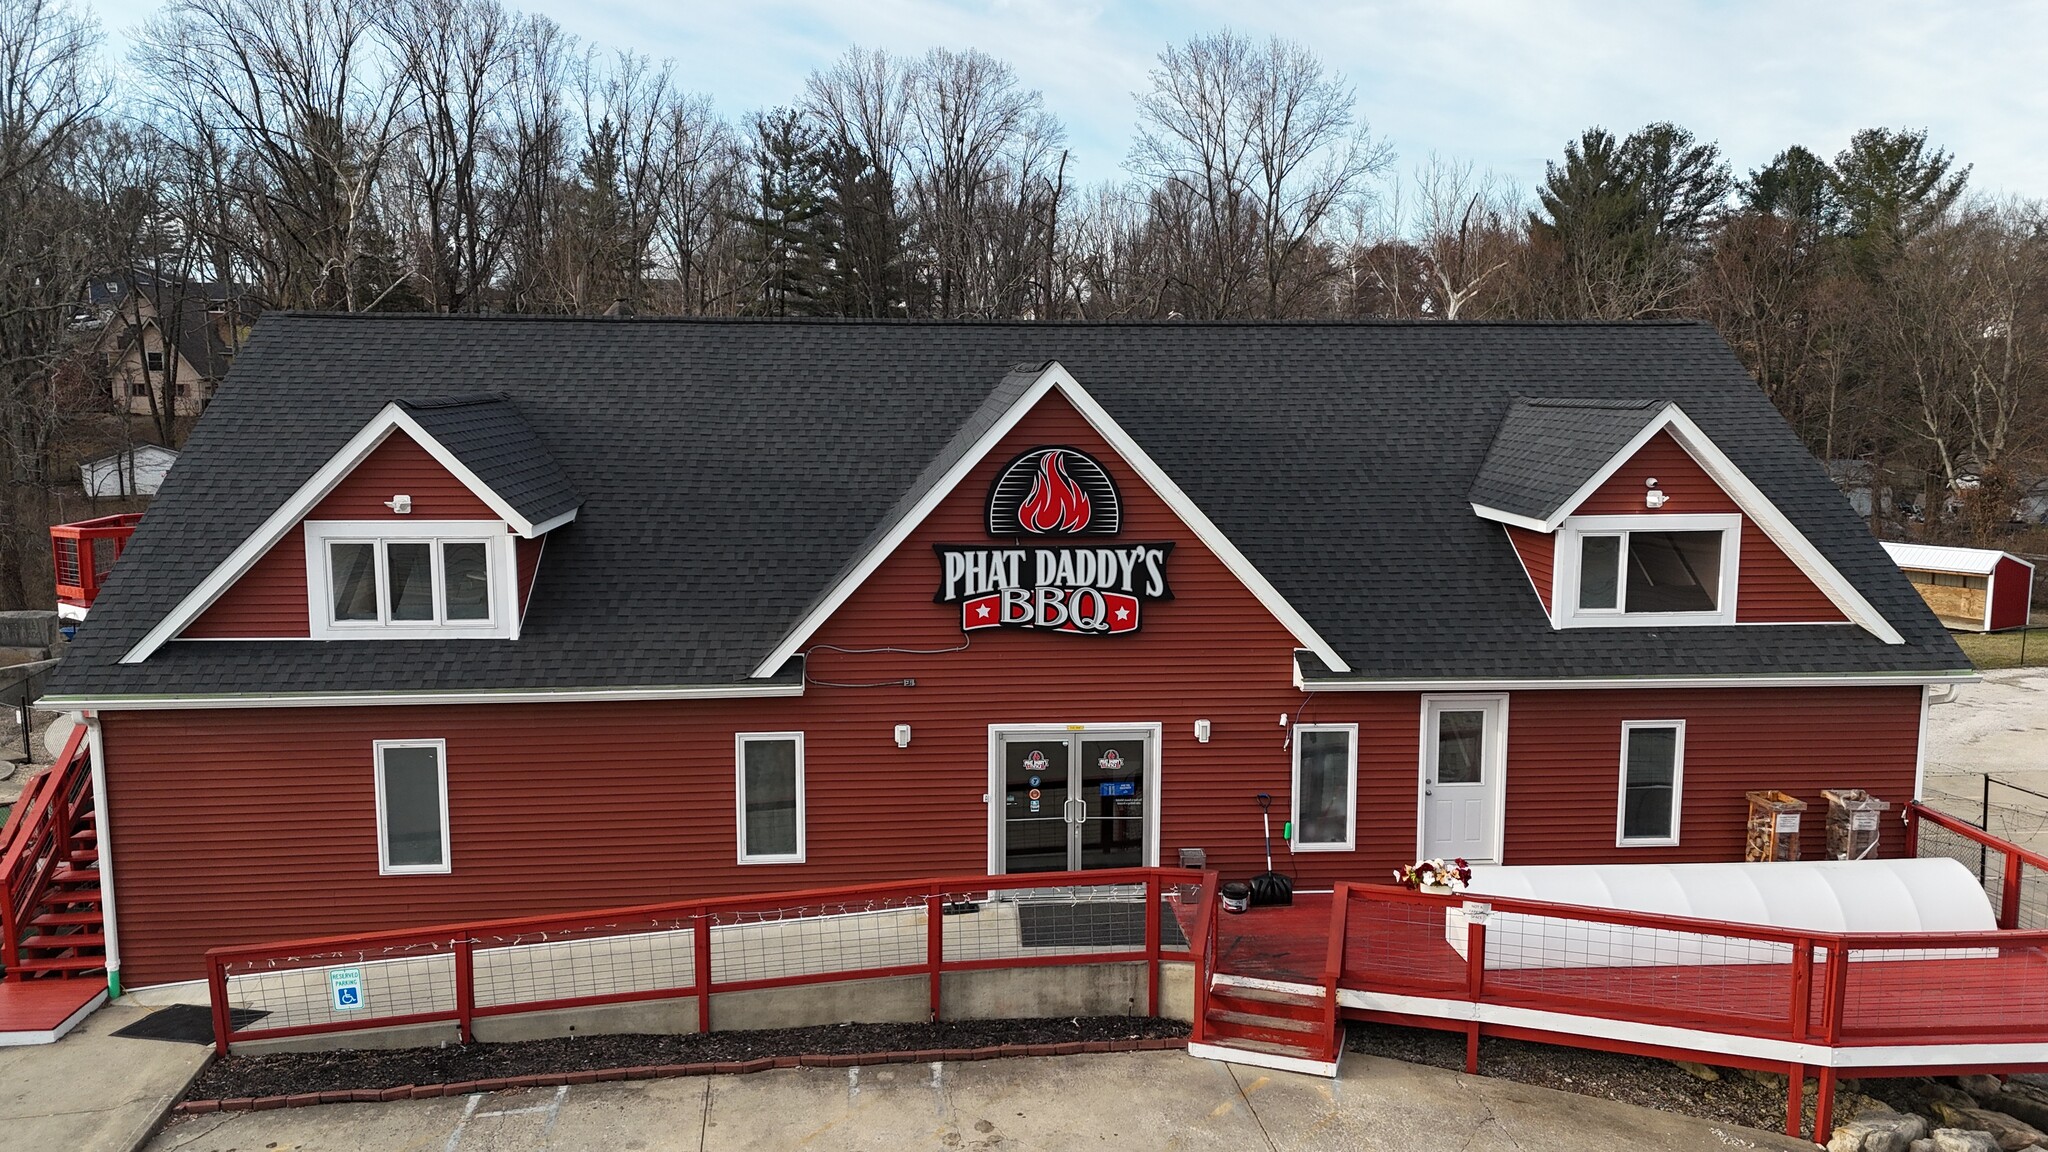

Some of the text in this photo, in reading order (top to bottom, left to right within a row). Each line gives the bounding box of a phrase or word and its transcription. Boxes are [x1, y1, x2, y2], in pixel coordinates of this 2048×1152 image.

[943, 545, 1164, 601] PHAT DADDY'S
[1000, 586, 1109, 630] BBQ
